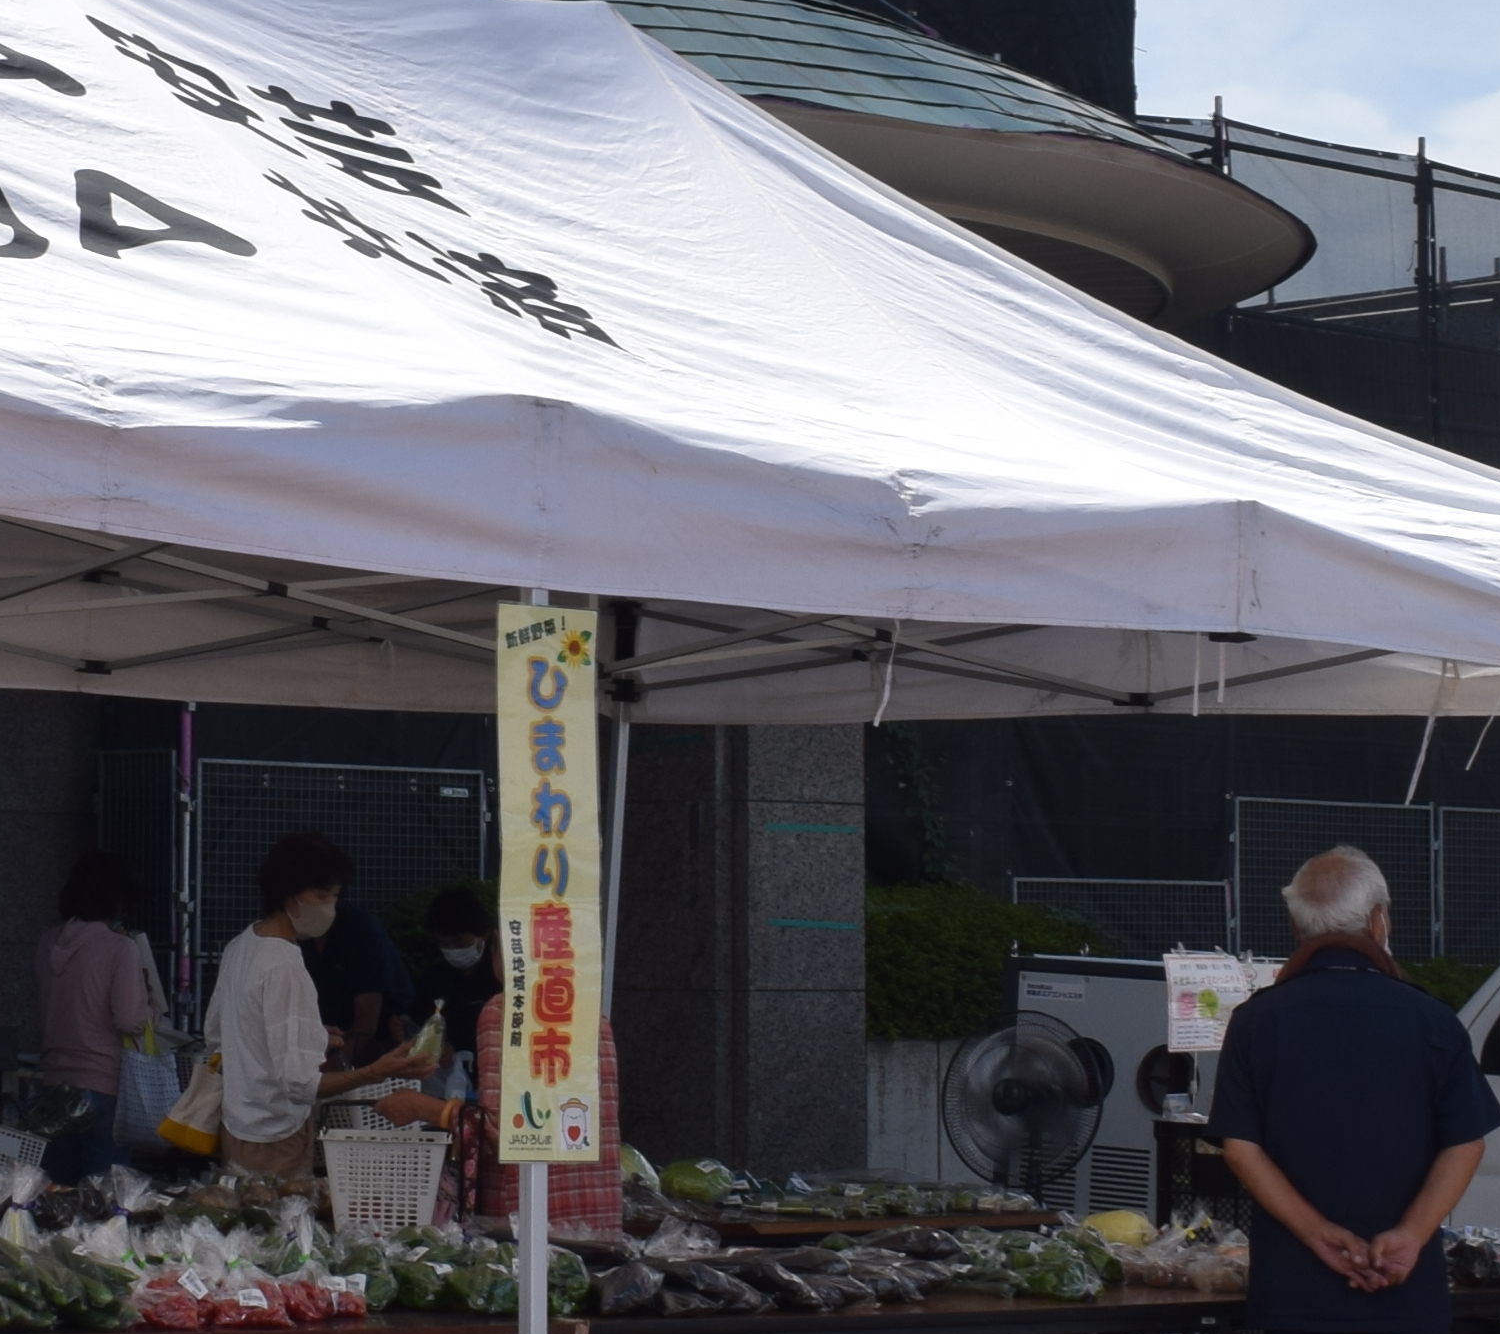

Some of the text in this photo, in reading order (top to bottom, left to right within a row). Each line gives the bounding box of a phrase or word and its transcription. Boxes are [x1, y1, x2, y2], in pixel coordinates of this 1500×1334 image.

[527, 657, 575, 1087] ひまわり産直市
